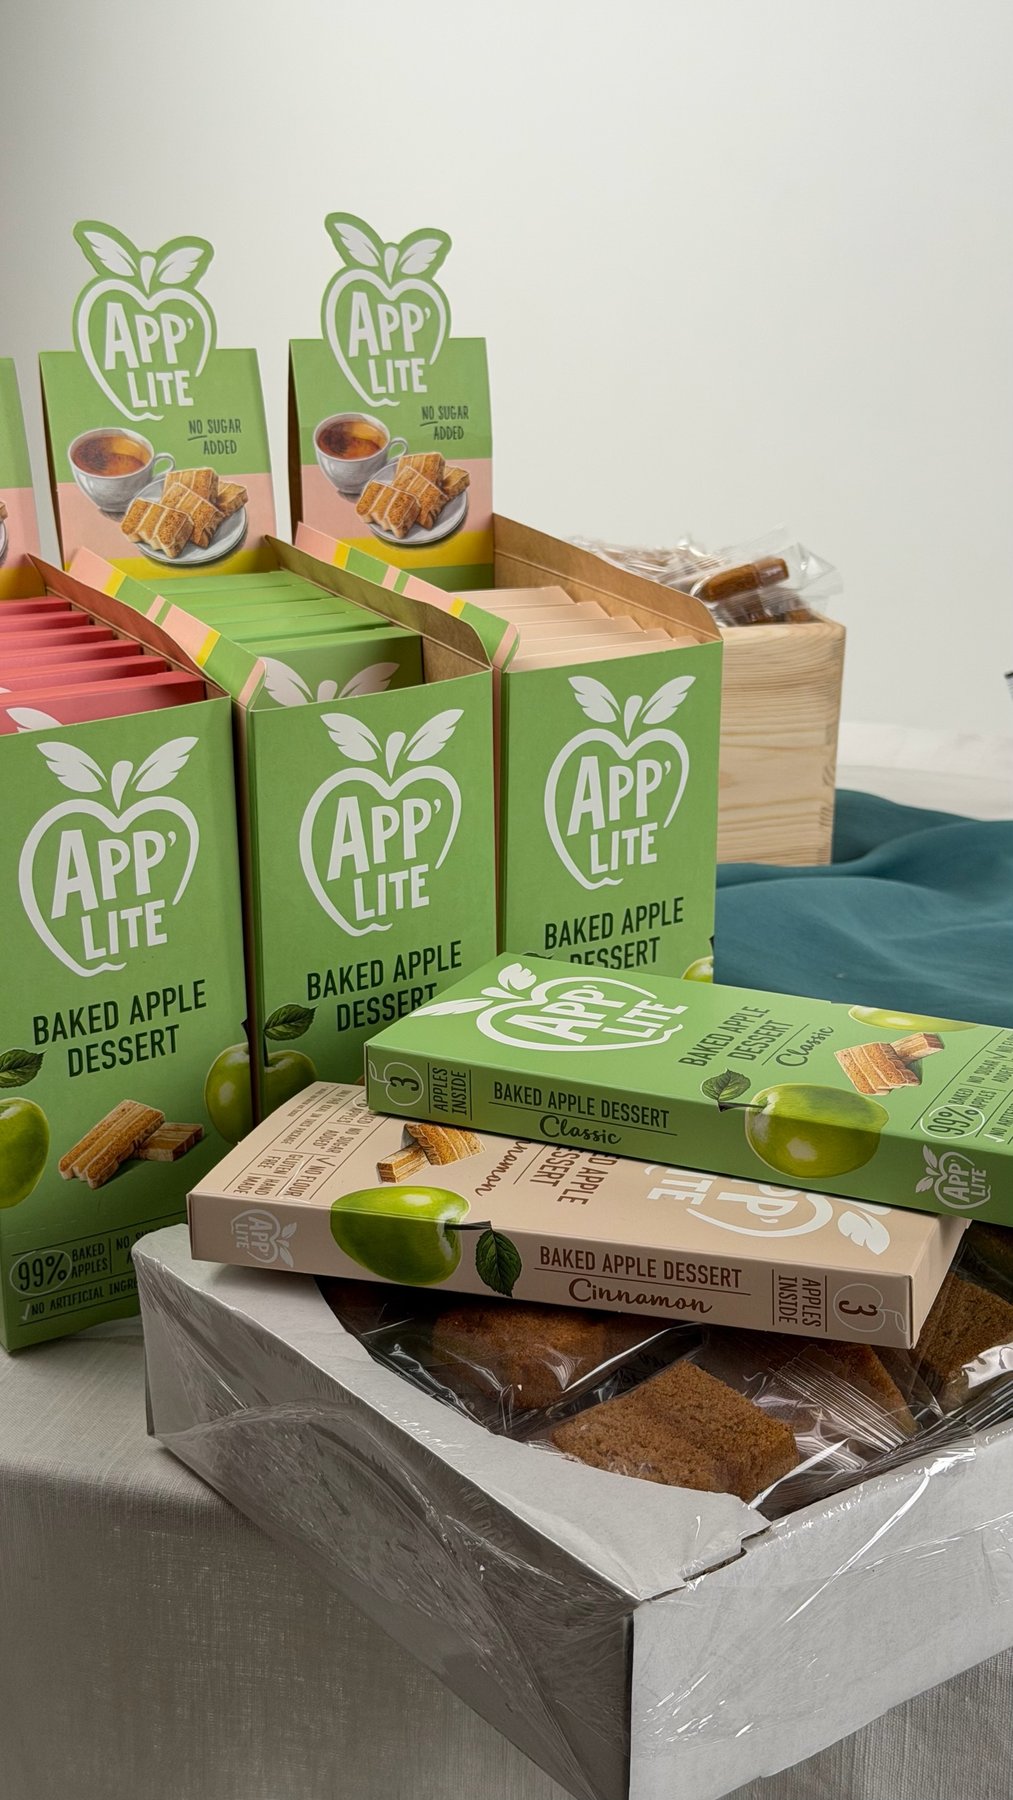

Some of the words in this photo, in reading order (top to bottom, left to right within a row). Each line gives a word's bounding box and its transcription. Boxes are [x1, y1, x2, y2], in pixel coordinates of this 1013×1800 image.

[105, 302, 194, 370] APP'
[348, 292, 431, 357] APP'
[127, 370, 193, 408] LITE
[368, 357, 427, 393] LITE
[189, 419, 203, 434] NO
[207, 418, 242, 434] SUGAR
[421, 405, 435, 420] NO
[438, 405, 469, 420] SUGAR
[203, 439, 237, 455] ADDED
[433, 425, 464, 440] ADDED
[567, 756, 672, 836] APP'
[327, 796, 441, 881] APP'
[590, 822, 658, 875] LITE
[51, 829, 177, 919] APP'
[354, 864, 430, 921] LITE
[81, 899, 168, 960] LITE
[545, 912, 613, 950] BAKED
[621, 896, 684, 935] APPLE
[307, 959, 384, 1001] BAKED
[393, 940, 462, 983] APPLE
[33, 1000, 120, 1045] BAKED
[129, 979, 207, 1025] APPLE
[337, 983, 437, 1032] DESSERT
[505, 984, 626, 1043] APP'
[601, 1000, 689, 1038] LITE
[68, 1024, 180, 1078] DESSERT
[678, 1033, 735, 1067] BAKED
[718, 1006, 770, 1033] APPLE
[727, 1020, 793, 1061] DESSERT
[775, 1026, 834, 1067] Classic
[390, 1076, 419, 1091] 3
[432, 1067, 448, 1112] APPLES
[451, 1070, 467, 1116] INSIDE
[948, 1087, 974, 1105] BAKED
[969, 1090, 997, 1109] APPLES
[494, 1081, 542, 1106] BAKED
[548, 1091, 595, 1116] APPLE
[601, 1100, 670, 1128] DESSERT
[927, 1106, 980, 1136] 99%
[325, 1136, 354, 1153] SUGAR
[540, 1114, 622, 1145] Classic
[257, 1155, 281, 1169] FREE
[273, 1154, 304, 1174] GLUTEN
[304, 1165, 326, 1175] NO
[943, 1159, 970, 1203] APP'
[233, 1176, 262, 1194] MADE
[255, 1178, 280, 1195] HAND
[283, 1175, 317, 1197] FLOUR
[557, 1166, 609, 1204] APPLE
[647, 1169, 718, 1205] ITE
[970, 1167, 987, 1197] LITE
[235, 1223, 249, 1249] LITE
[18, 1253, 67, 1291] 99%
[72, 1243, 105, 1262] BAKED
[116, 1236, 130, 1250] NO
[71, 1258, 108, 1279] APPLES
[540, 1246, 596, 1270] BAKED
[602, 1253, 657, 1278] APPLE
[663, 1260, 742, 1288] DESSERT
[31, 1303, 45, 1316] NO
[50, 1286, 104, 1310] ARTIFICIAL
[568, 1278, 713, 1314] Cinnamon
[778, 1275, 798, 1324] INSIDE
[802, 1277, 821, 1327] APPLES
[838, 1300, 878, 1316] 3
